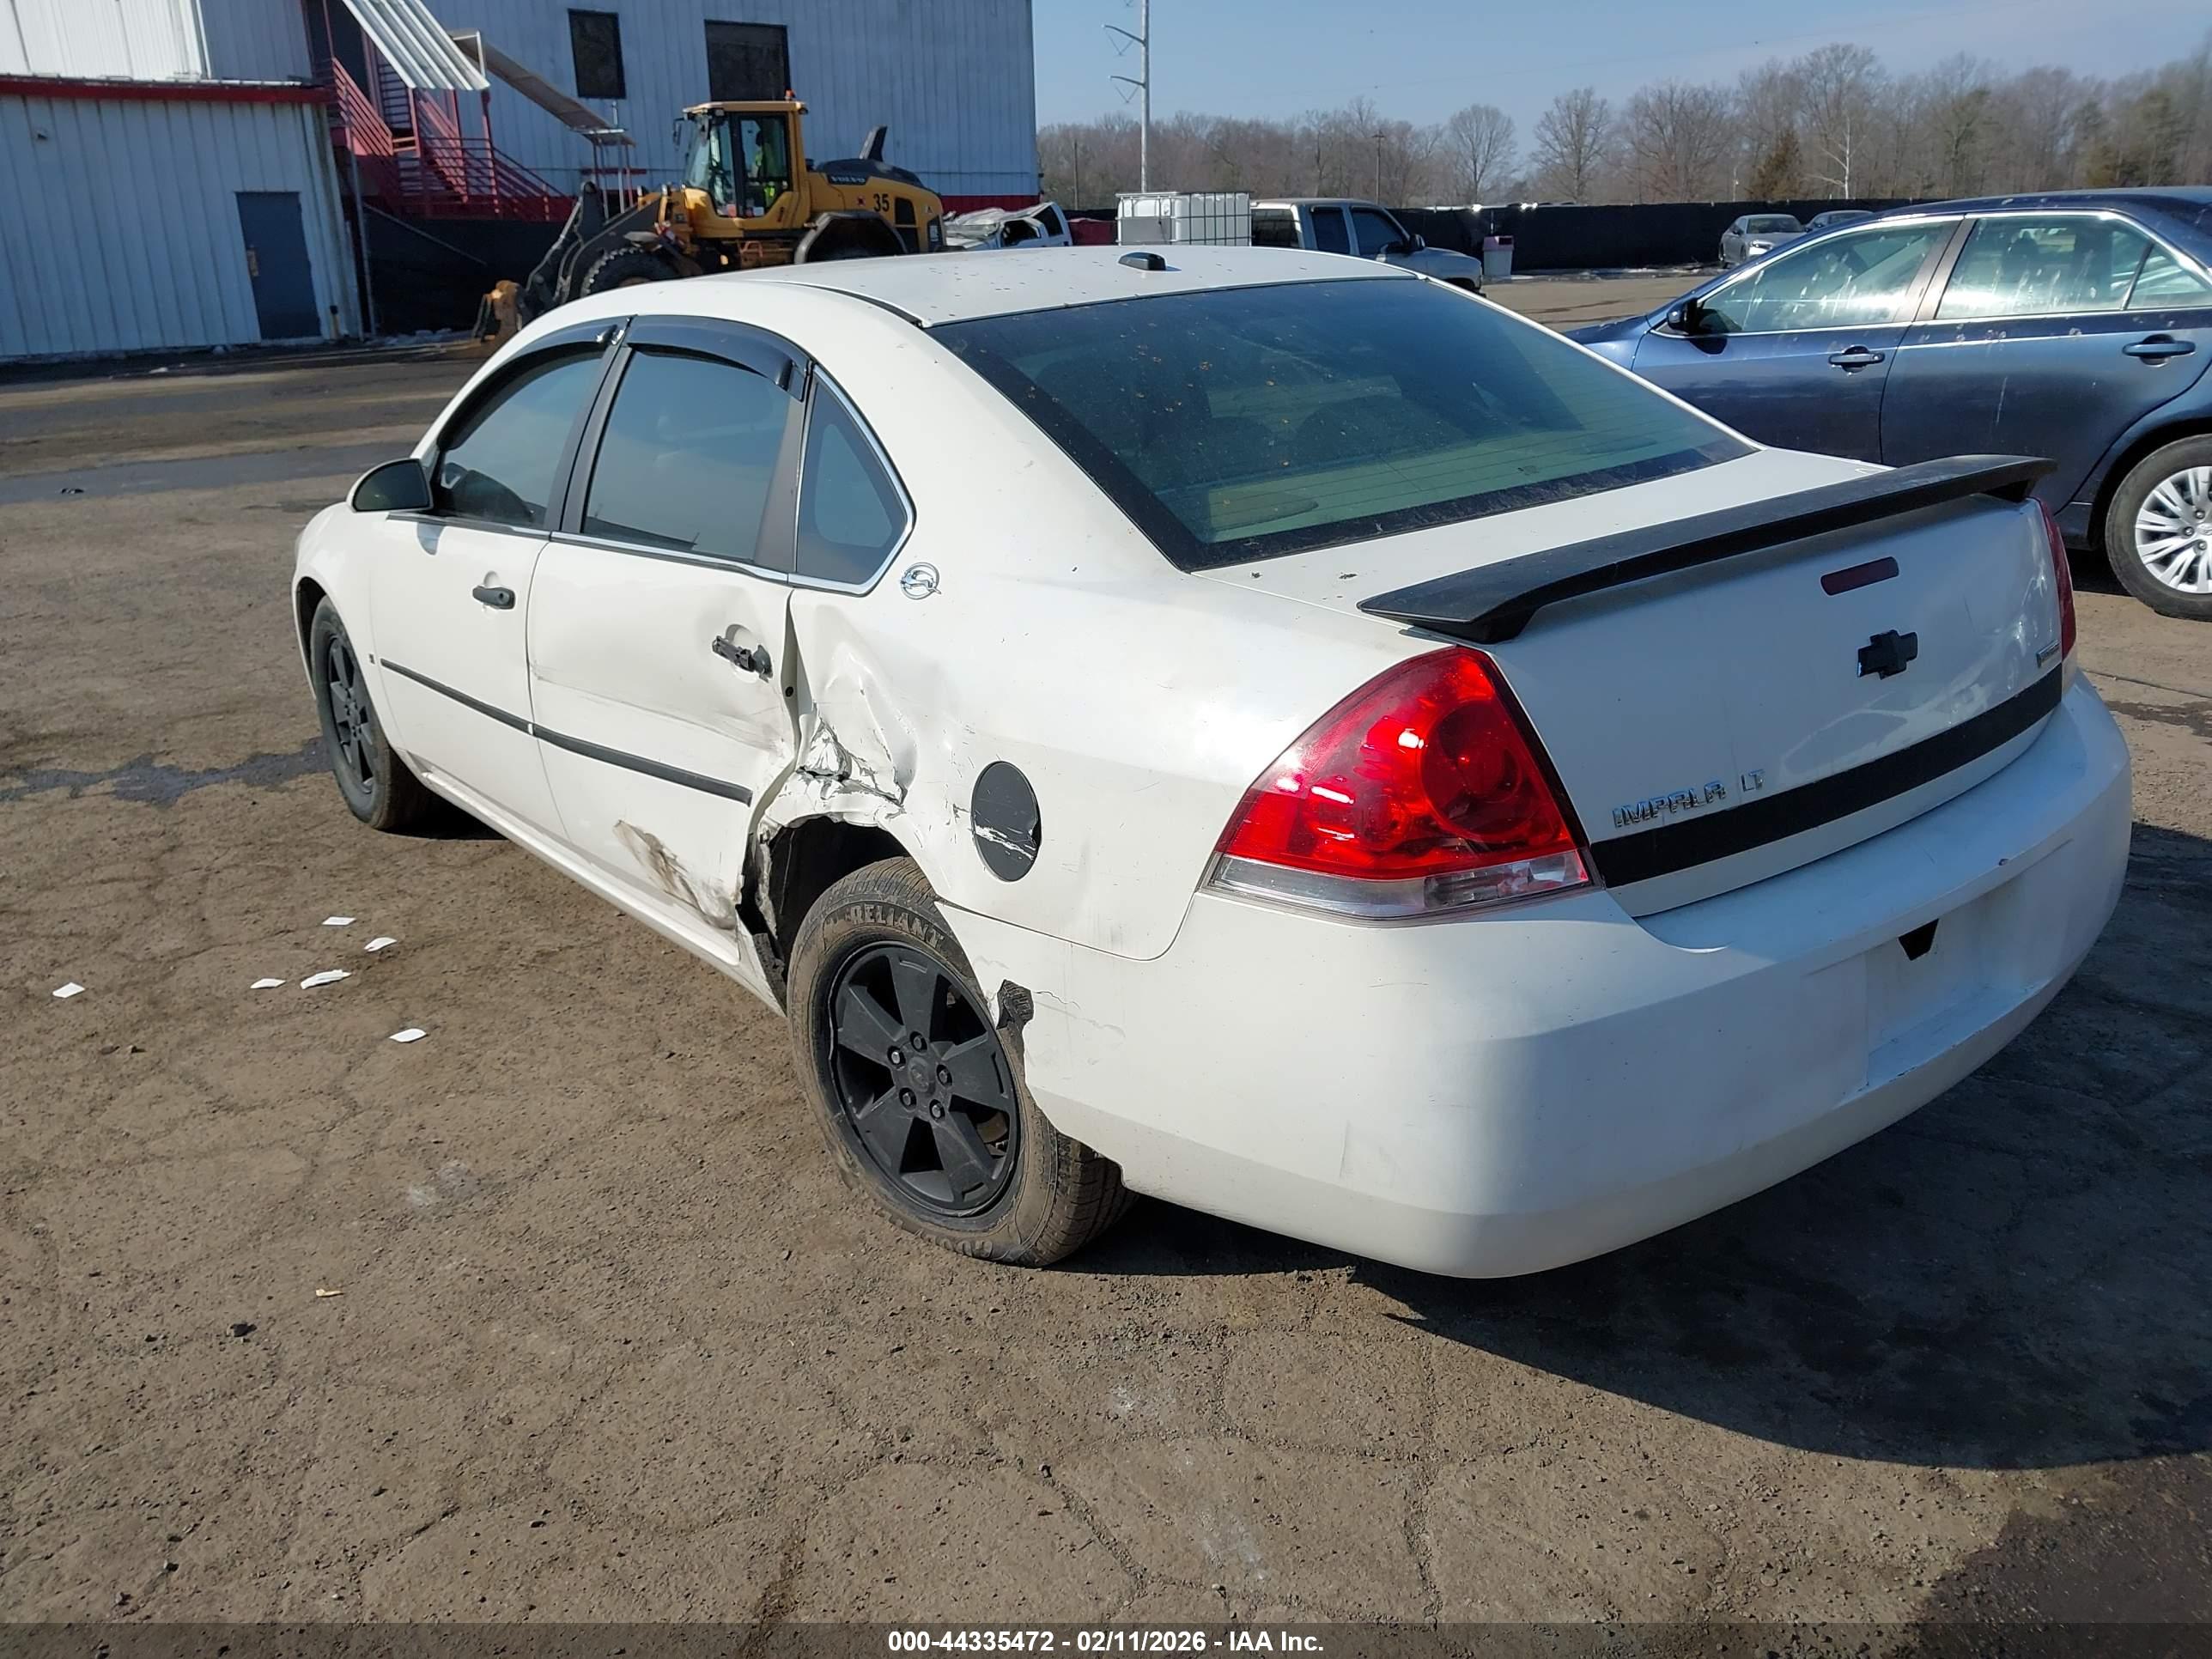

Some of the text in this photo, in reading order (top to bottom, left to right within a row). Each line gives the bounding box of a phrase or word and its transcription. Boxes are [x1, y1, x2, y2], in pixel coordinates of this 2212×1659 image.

[872, 193, 890, 212] 35
[1613, 769, 1765, 828] IMPALA LT
[850, 903, 944, 949] RELIANT
